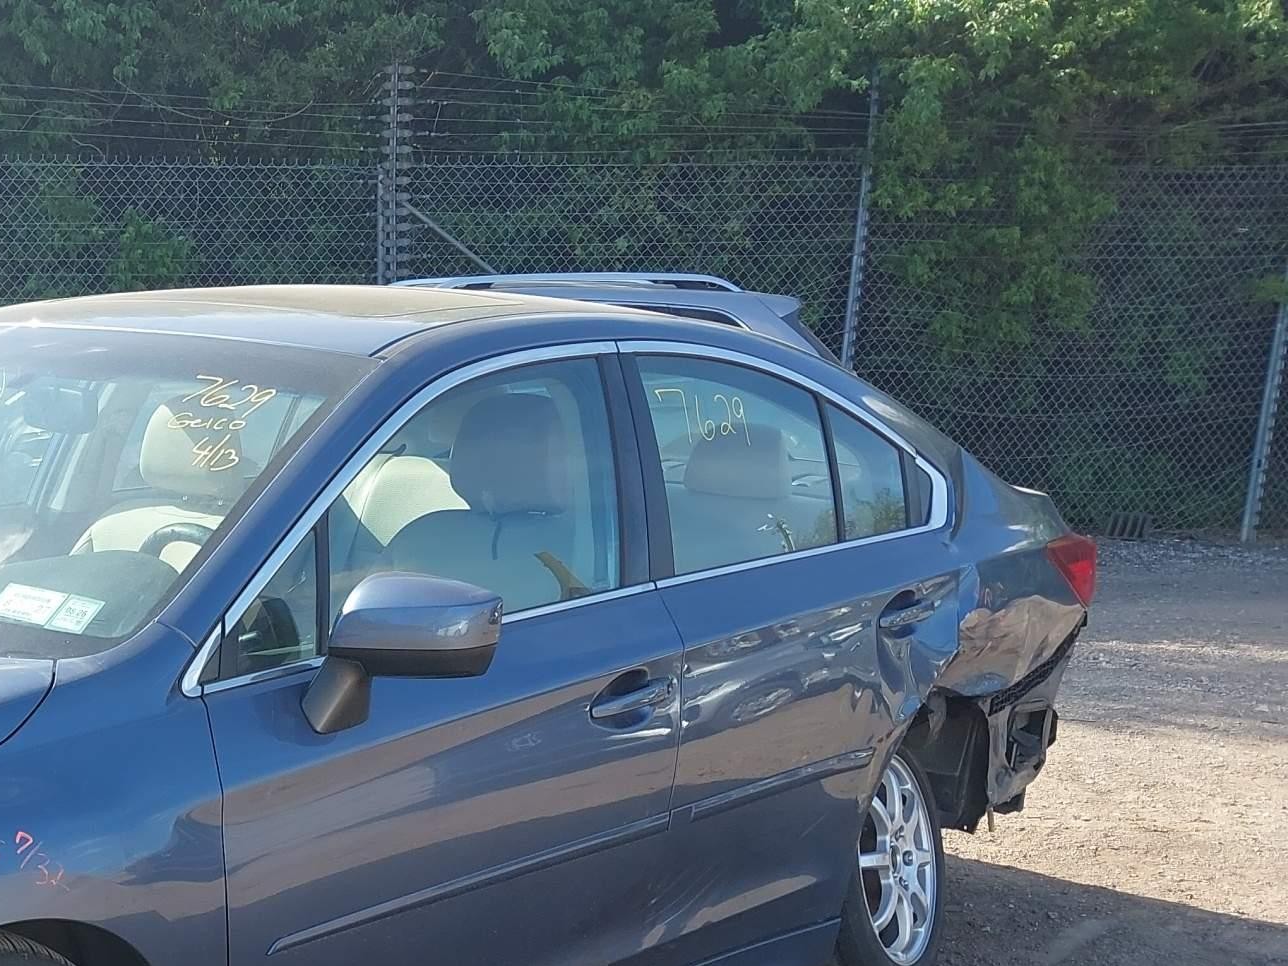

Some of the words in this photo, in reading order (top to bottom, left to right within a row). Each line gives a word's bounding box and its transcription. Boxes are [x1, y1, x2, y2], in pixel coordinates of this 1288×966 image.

[182, 374, 277, 418] 7629
[654, 388, 751, 447] 7629
[191, 434, 240, 471] 4/13
